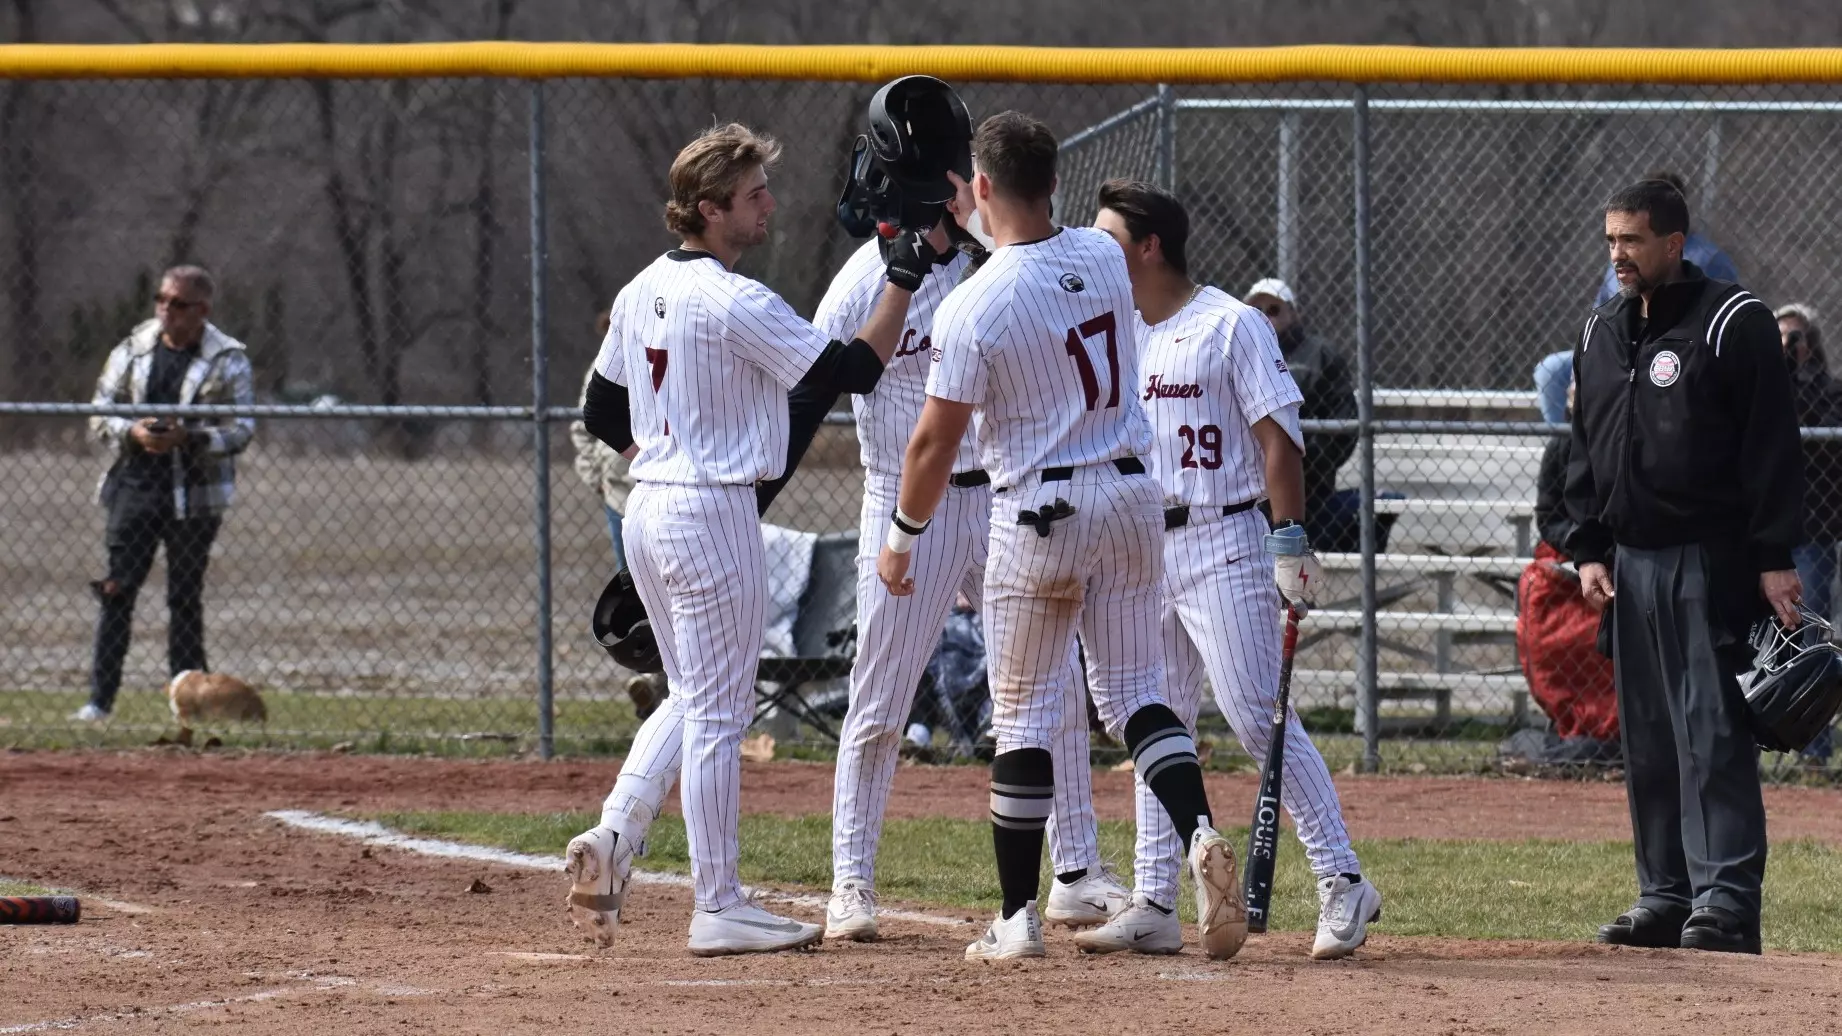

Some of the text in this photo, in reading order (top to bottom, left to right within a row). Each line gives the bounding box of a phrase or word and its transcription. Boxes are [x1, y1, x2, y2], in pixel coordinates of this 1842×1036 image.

[895, 328, 931, 358] Lo
[1065, 311, 1120, 412] 17
[645, 347, 670, 436] 7
[1143, 373, 1204, 402] Haven
[1178, 425, 1223, 470] 29
